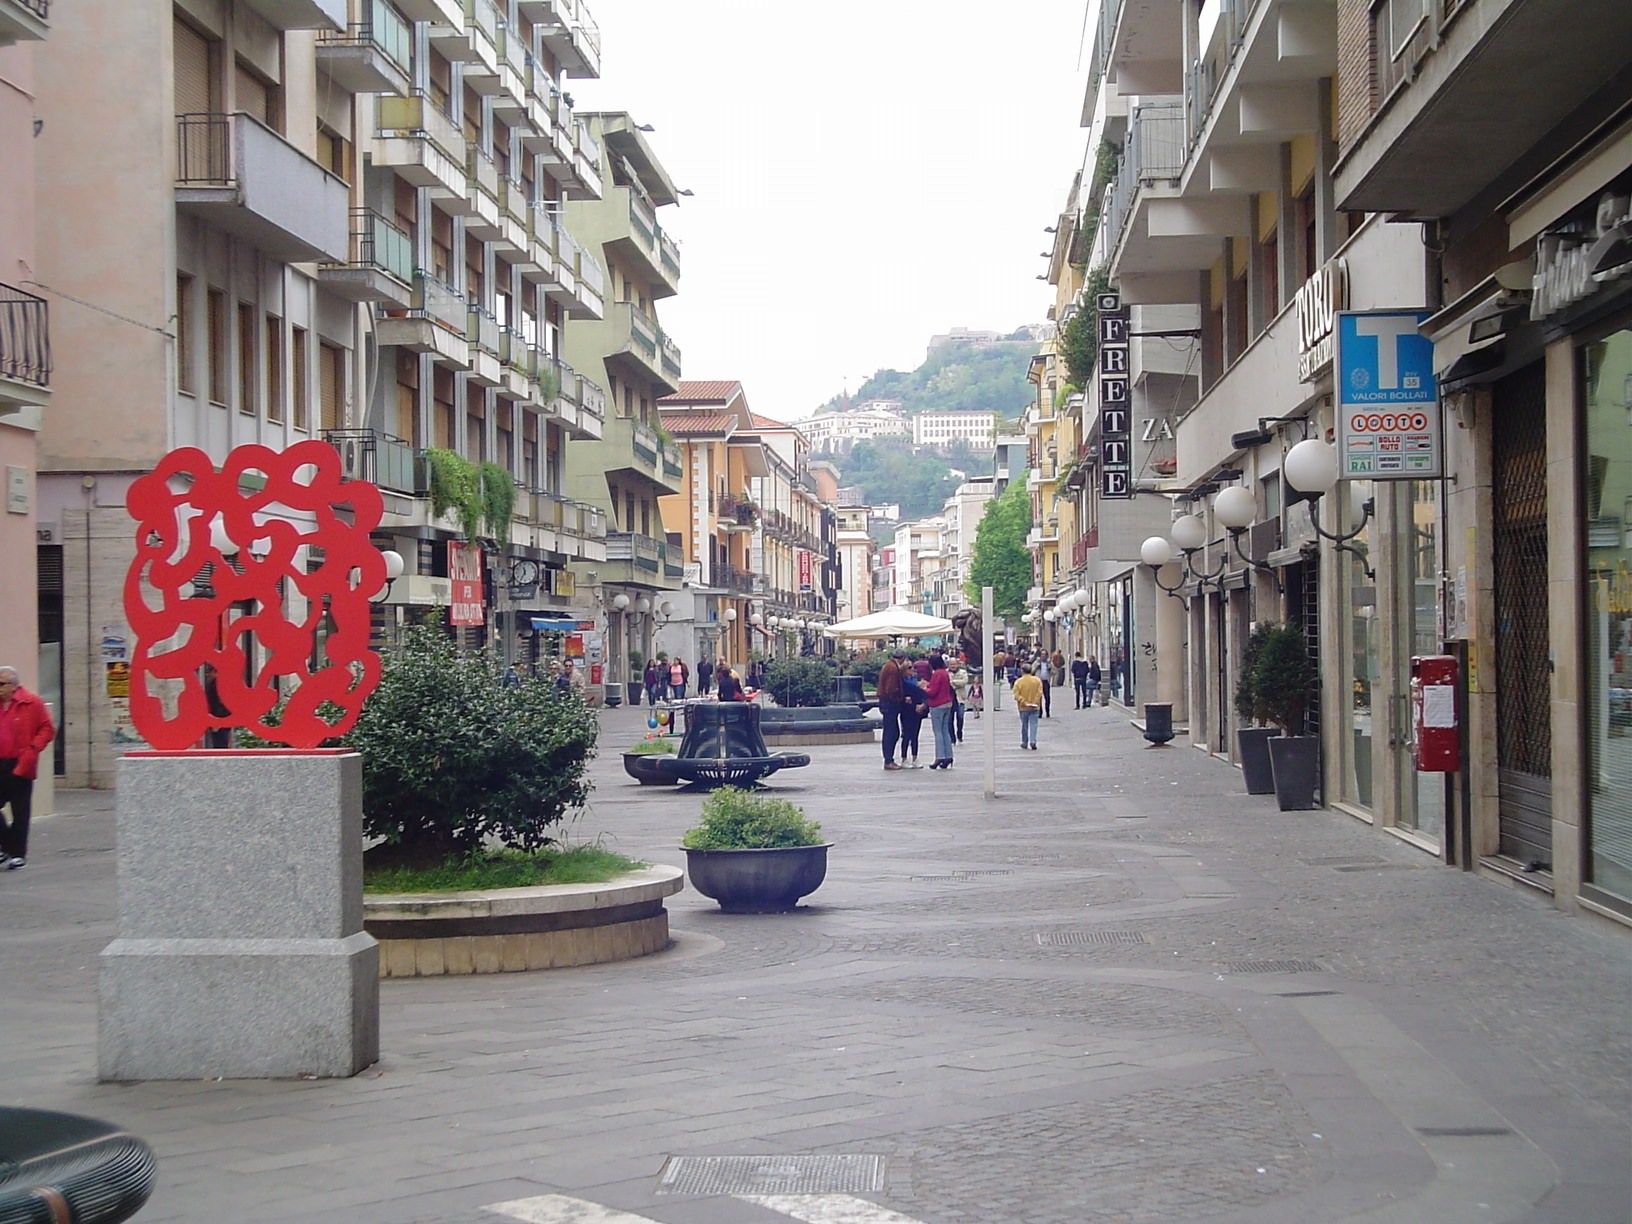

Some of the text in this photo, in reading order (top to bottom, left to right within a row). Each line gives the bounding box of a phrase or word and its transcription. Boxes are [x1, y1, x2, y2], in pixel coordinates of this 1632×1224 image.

[1295, 263, 1334, 354] TORO
[1356, 316, 1418, 390] T
[1103, 319, 1127, 494] FRETTE
[1352, 391, 1427, 400] VALORI BOLLATI
[1351, 461, 1372, 471] RAI
